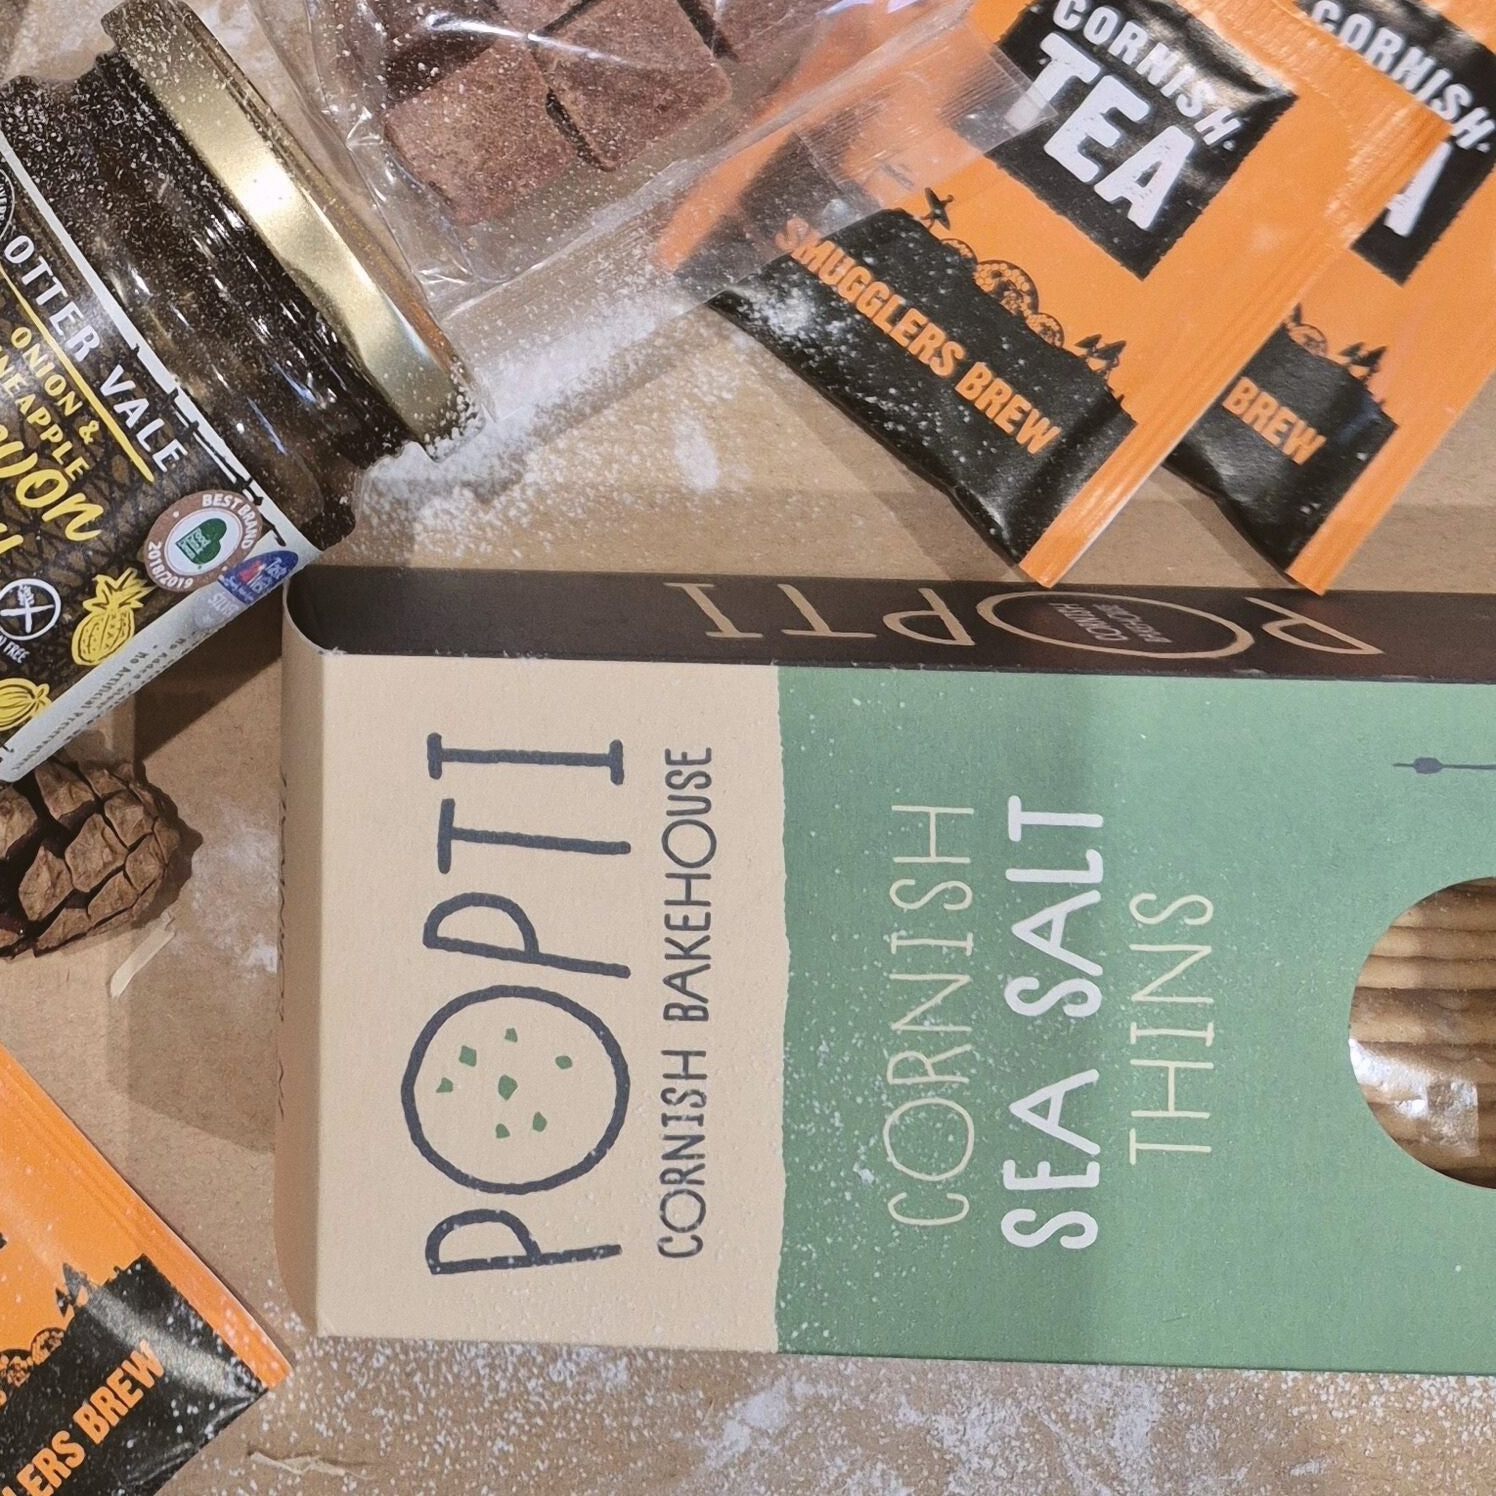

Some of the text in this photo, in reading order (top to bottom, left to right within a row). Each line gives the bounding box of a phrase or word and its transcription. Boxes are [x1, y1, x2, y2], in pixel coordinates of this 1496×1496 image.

[1005, 32, 1195, 232] TEA
[4, 234, 188, 473] OTTER VALE
[10, 326, 101, 445] ONION &
[774, 215, 1061, 456] SMUGGLERS BREW
[1221, 376, 1326, 466] BREW
[148, 540, 194, 589] 2018/2019
[201, 493, 258, 550] BEST BRAND
[662, 580, 1385, 659] POPTI
[4, 639, 31, 665] FREE
[400, 730, 632, 1277] POPTI
[658, 745, 715, 1260] CORNISH BAKEHOUSE
[887, 804, 976, 1228] CORNISH
[1002, 794, 1105, 1251] SEA SALT
[1127, 891, 1215, 1166] THINS
[72, 1338, 165, 1445] BREW
